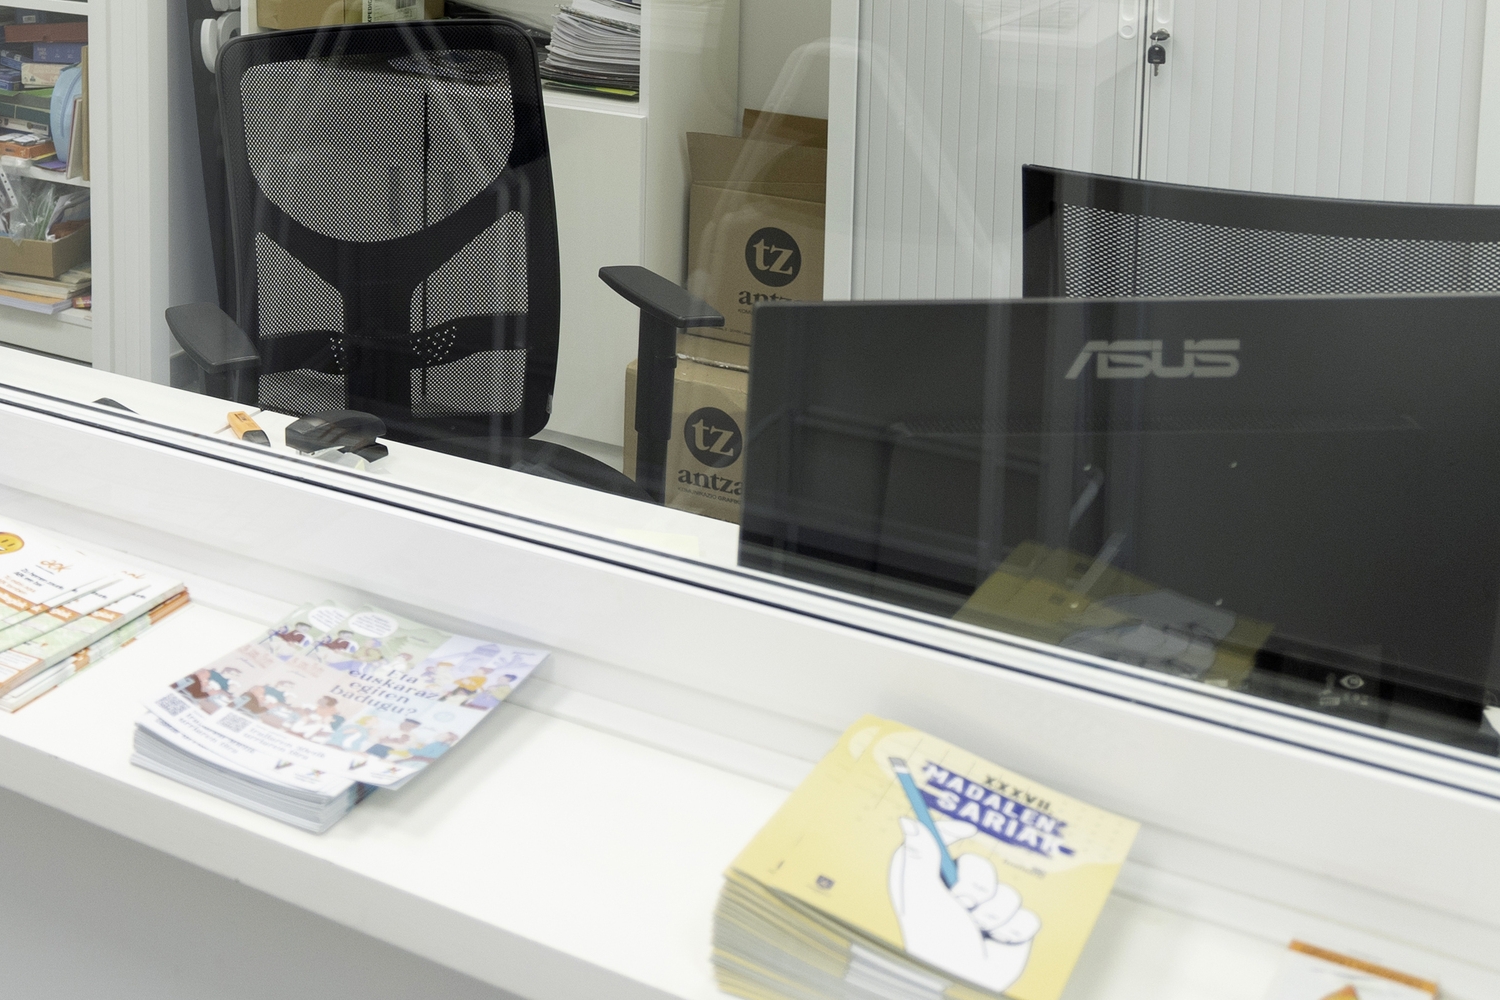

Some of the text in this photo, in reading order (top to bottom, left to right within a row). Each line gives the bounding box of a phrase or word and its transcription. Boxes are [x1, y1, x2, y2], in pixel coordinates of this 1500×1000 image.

[754, 238, 794, 275] tz
[1064, 338, 1240, 380] ASUS
[691, 418, 734, 457] tz
[348, 669, 439, 699] euskaraz
[349, 681, 410, 704] egiten
[387, 669, 418, 684] Eta
[329, 684, 418, 716] badugu?
[923, 763, 1058, 833] MADALEN
[984, 775, 1051, 811] XXXVII
[935, 790, 1062, 853] SARIAK
